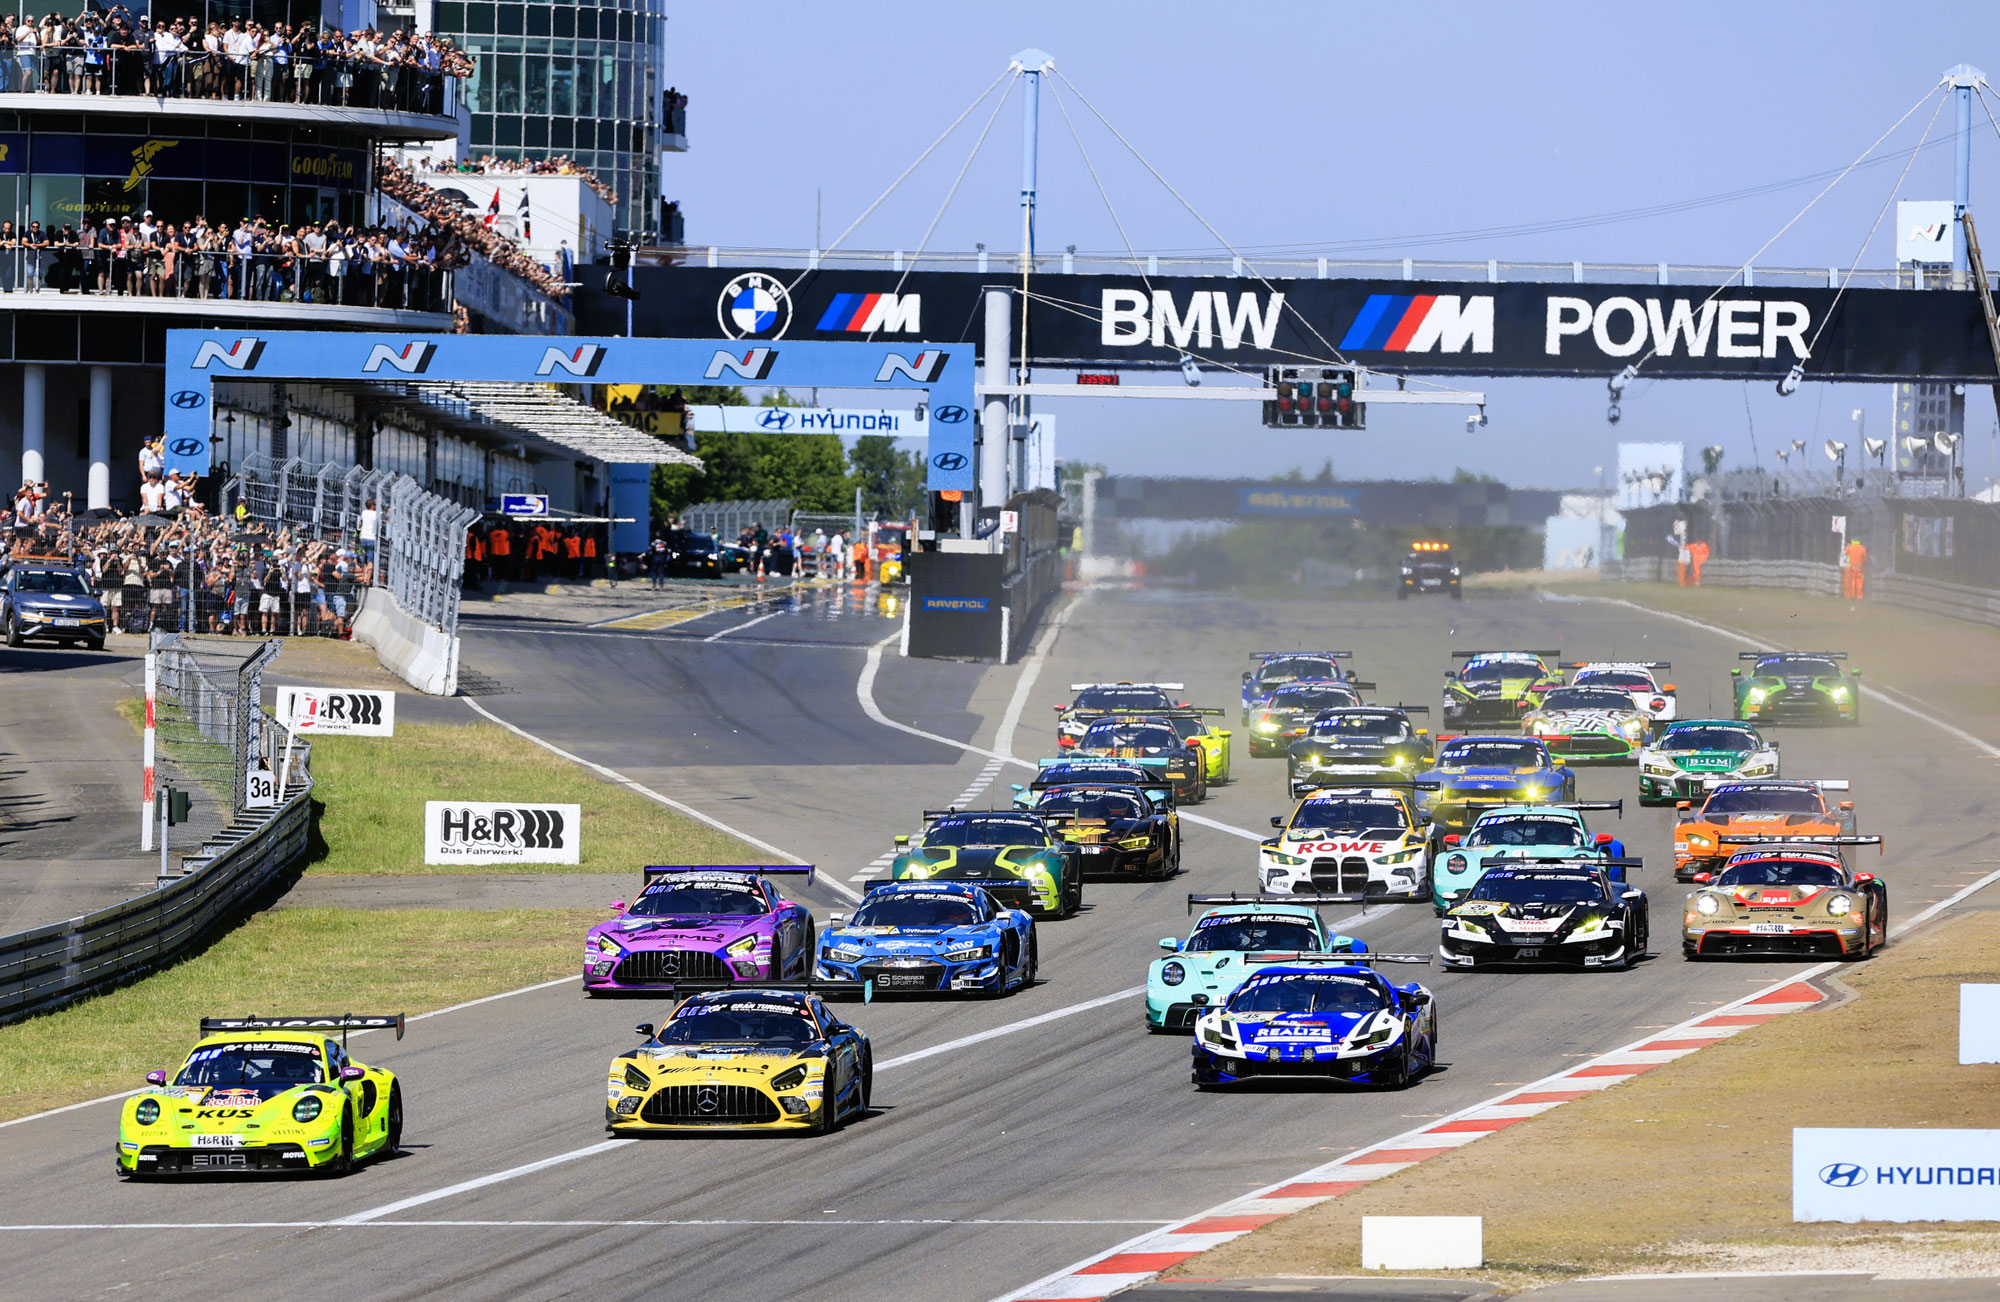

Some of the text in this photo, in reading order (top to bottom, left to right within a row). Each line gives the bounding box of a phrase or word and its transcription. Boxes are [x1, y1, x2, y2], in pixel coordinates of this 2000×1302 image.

[292, 154, 352, 180] GOODYEAR
[728, 276, 783, 298] BMW
[1100, 288, 1285, 350] BMW
[1545, 296, 1812, 359] POWER
[801, 413, 898, 430] HYUNDAI
[928, 600, 984, 608] RAVENOL
[250, 776, 271, 798] 3a
[443, 809, 518, 843] H&R
[466, 847, 523, 856] Fahrwerk!
[1297, 842, 1386, 855] ROWE
[660, 934, 723, 943] AMG
[837, 942, 861, 951] HYLO
[948, 939, 974, 951] HYLO
[1514, 949, 1543, 959] ABT
[757, 1004, 795, 1013] TURISMO
[1257, 1027, 1332, 1037] REALIZE
[692, 1065, 765, 1075] AMG
[206, 1096, 262, 1107] Red Bull
[196, 1109, 255, 1119] KÜS
[198, 1135, 219, 1145] H&R
[282, 1151, 305, 1159] MOTUL
